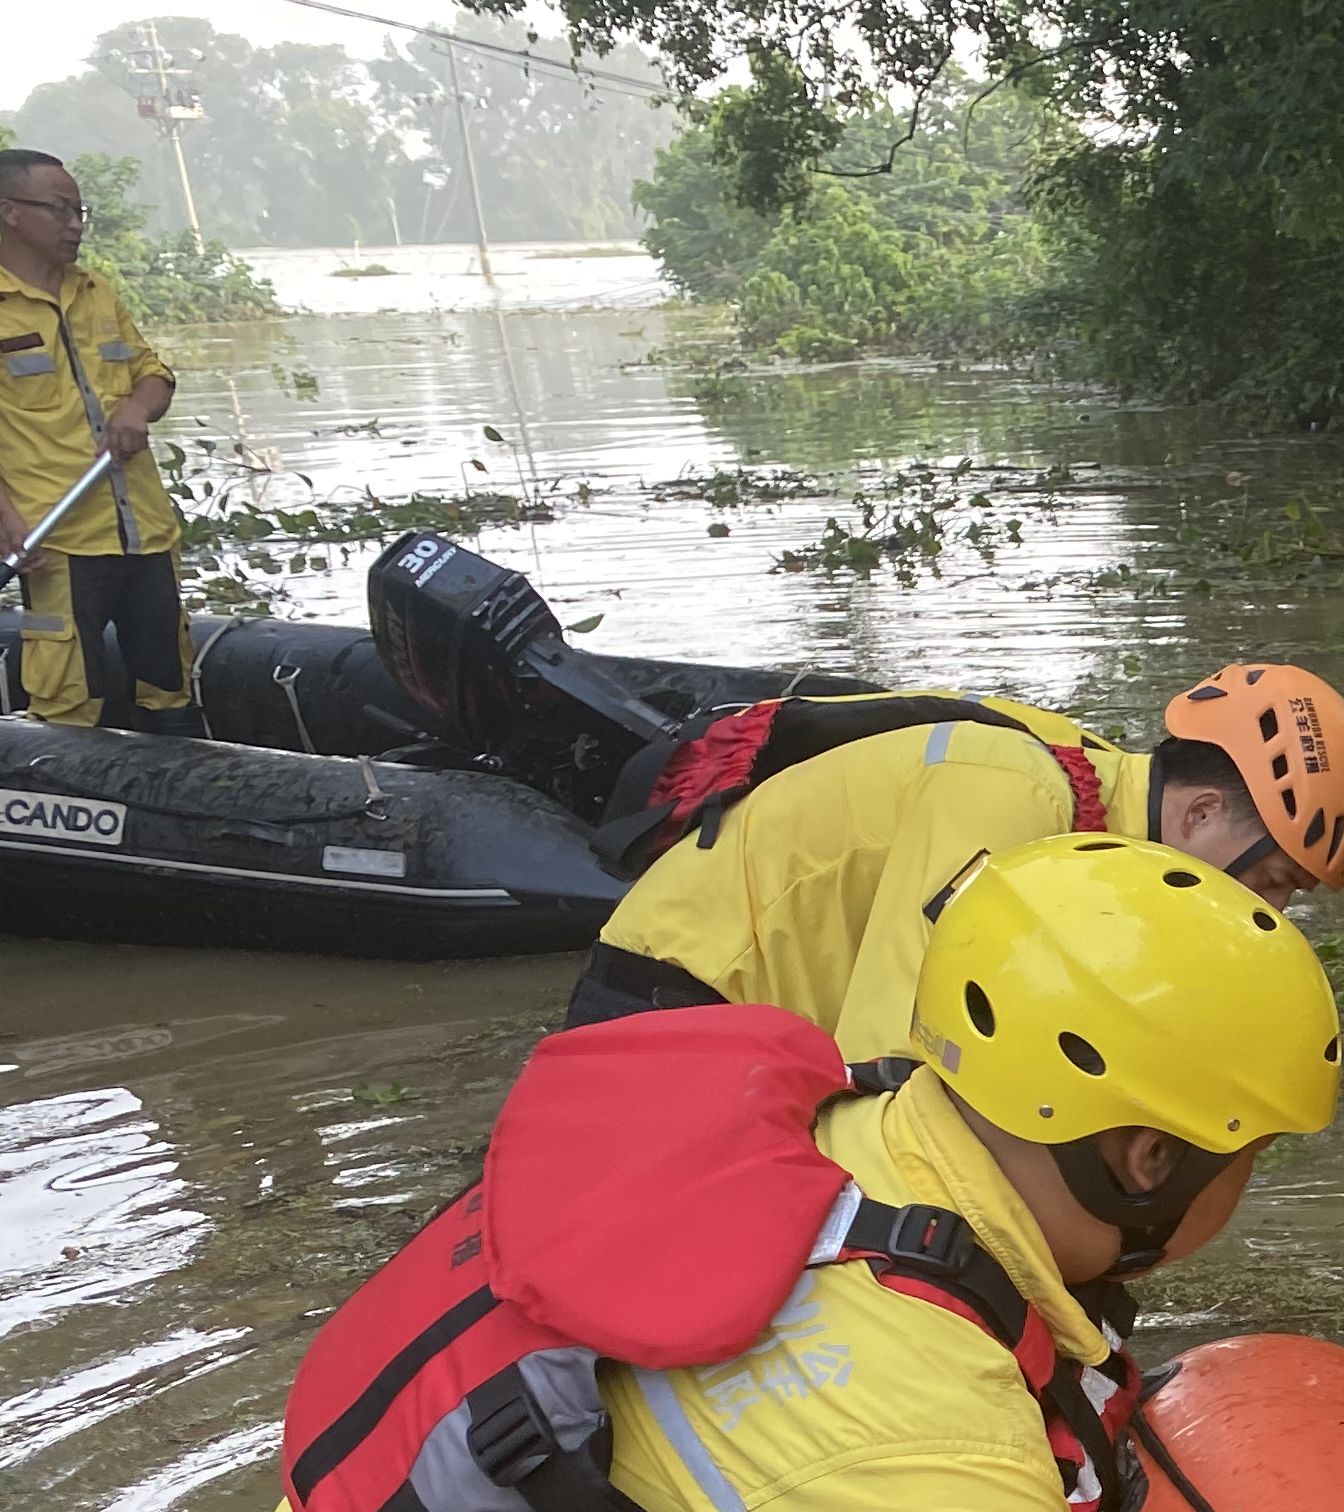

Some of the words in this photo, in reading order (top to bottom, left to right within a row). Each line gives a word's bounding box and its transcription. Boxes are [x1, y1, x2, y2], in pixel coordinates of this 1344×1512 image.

[398, 539, 439, 574] 30
[414, 546, 457, 588] MERCURY
[1315, 740, 1331, 773] RESCUE
